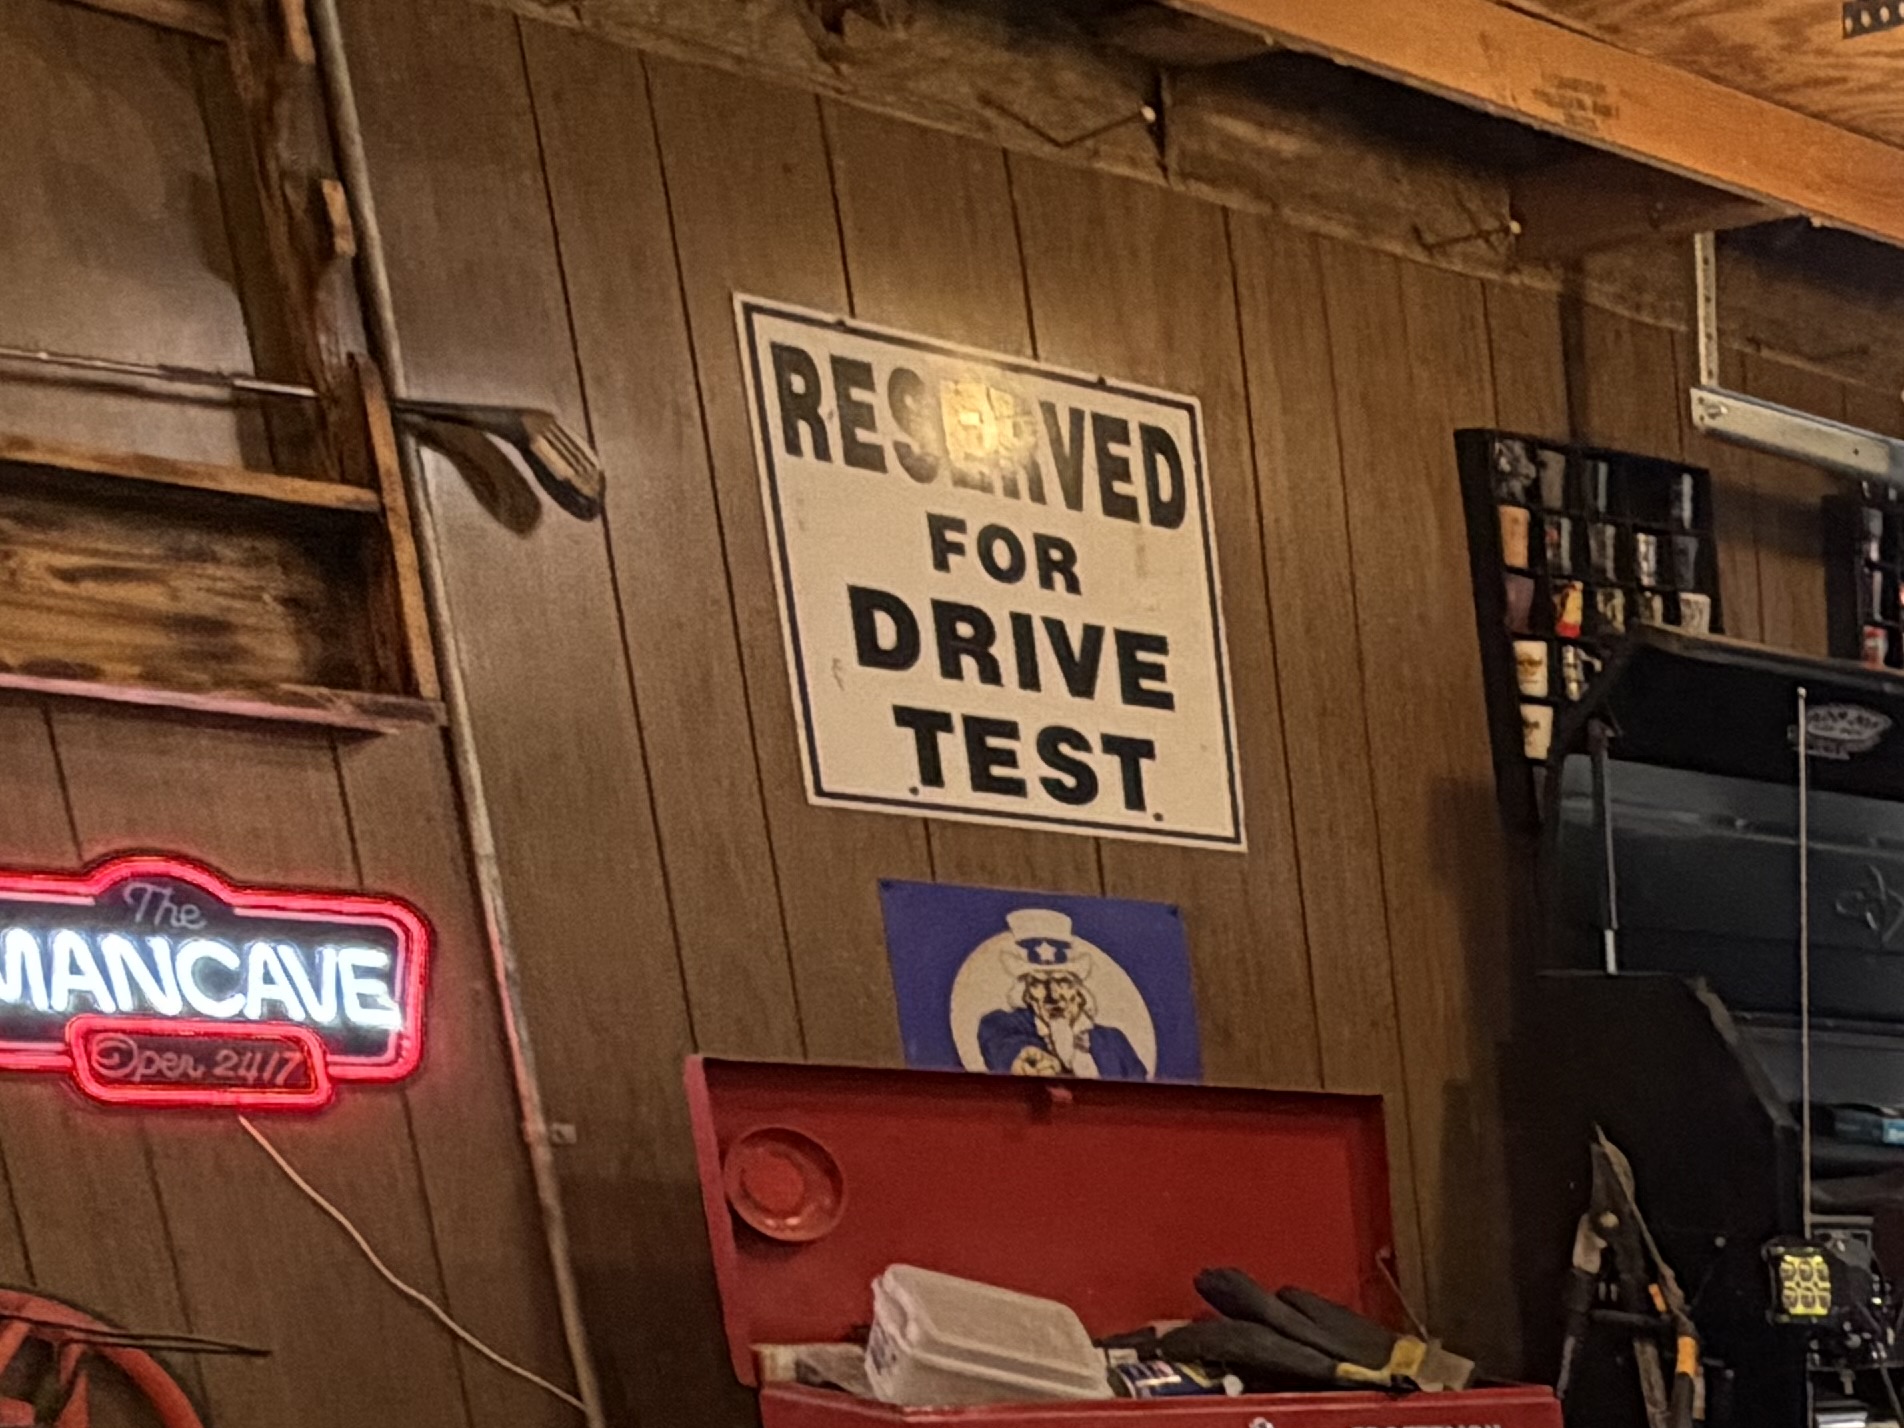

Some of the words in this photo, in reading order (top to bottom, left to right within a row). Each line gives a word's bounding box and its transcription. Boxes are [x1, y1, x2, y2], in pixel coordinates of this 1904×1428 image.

[769, 340, 1188, 530] RESERVED
[925, 511, 1083, 597] FOR
[847, 583, 1177, 713] DRIVE
[892, 703, 1157, 812] TEST
[122, 881, 207, 930] The
